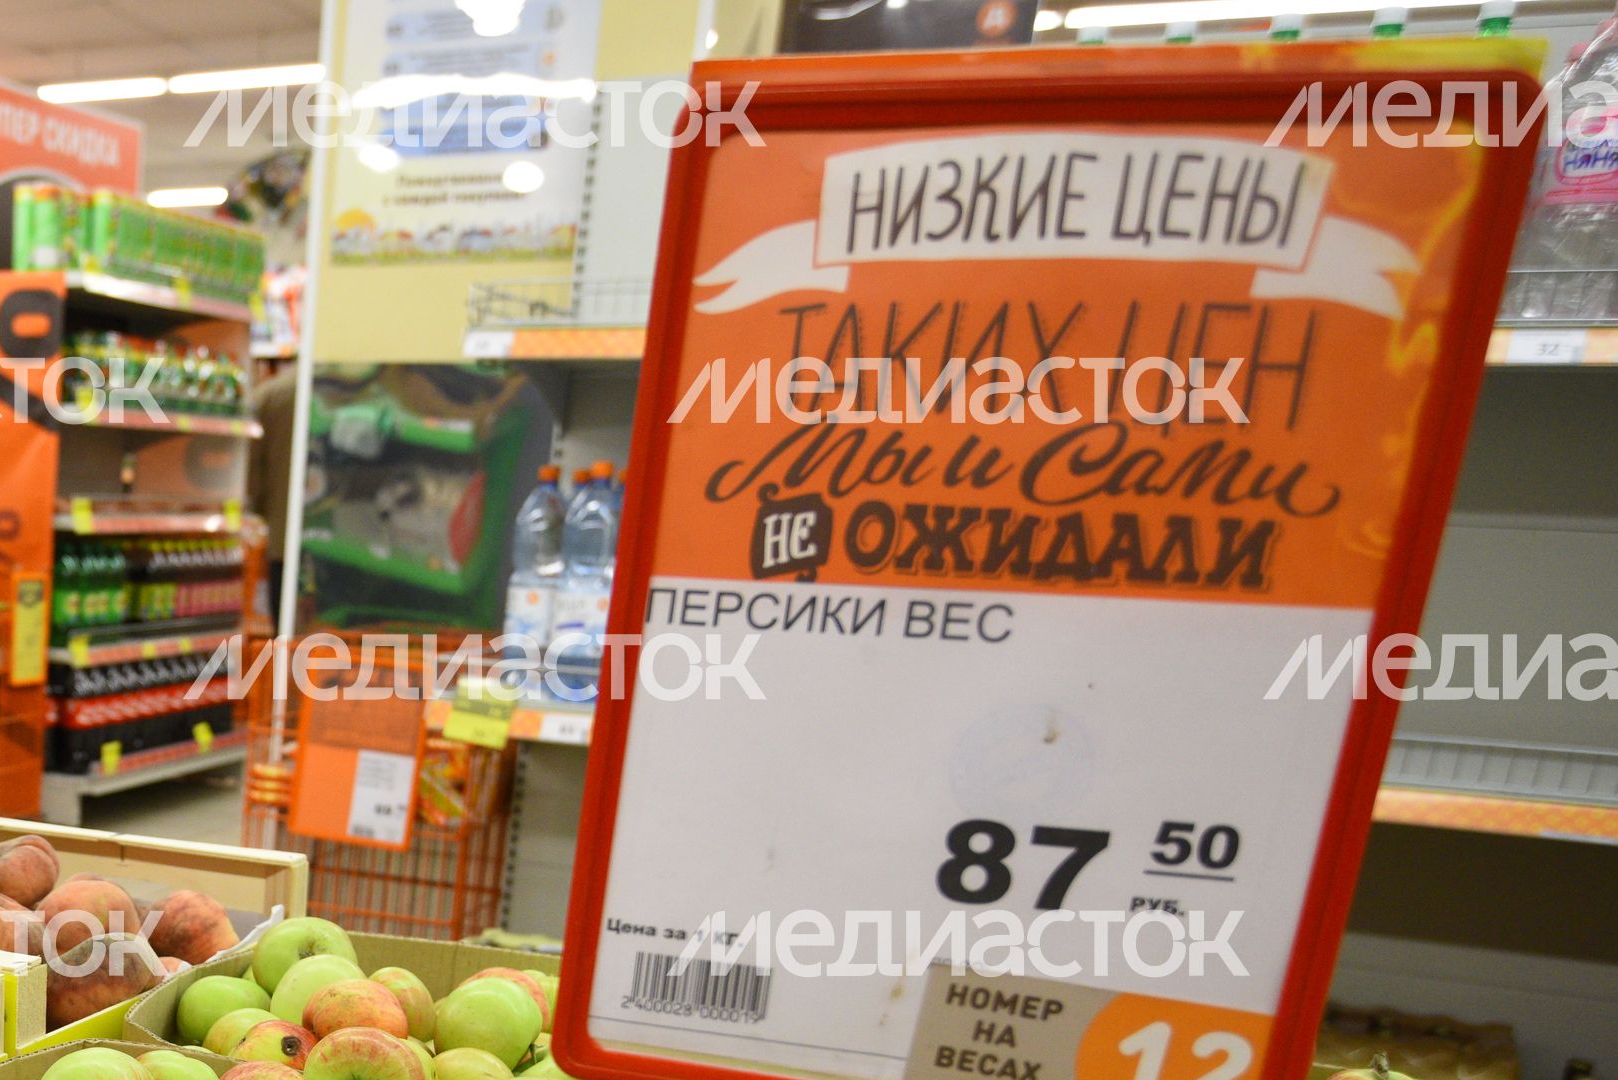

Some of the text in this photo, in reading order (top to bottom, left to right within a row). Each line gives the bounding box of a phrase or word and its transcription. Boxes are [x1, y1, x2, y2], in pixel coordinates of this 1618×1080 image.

[846, 151, 1308, 254] НИЗКИЕ ЦЕНЫ
[779, 300, 1318, 438] ТАКИХ ЦЕН
[704, 414, 936, 503] Мы
[943, 432, 1016, 488] и
[762, 499, 1278, 592] НЕ ОЖИДАЛИ
[644, 586, 1015, 644] ПЕРСИКИ ВЕС
[936, 819, 1240, 911] 87 50
[607, 918, 656, 937] Цена
[663, 926, 686, 940] за
[1130, 896, 1185, 917] РУБ.
[946, 983, 1064, 1021] НОМЕР
[971, 1019, 1016, 1048] НА
